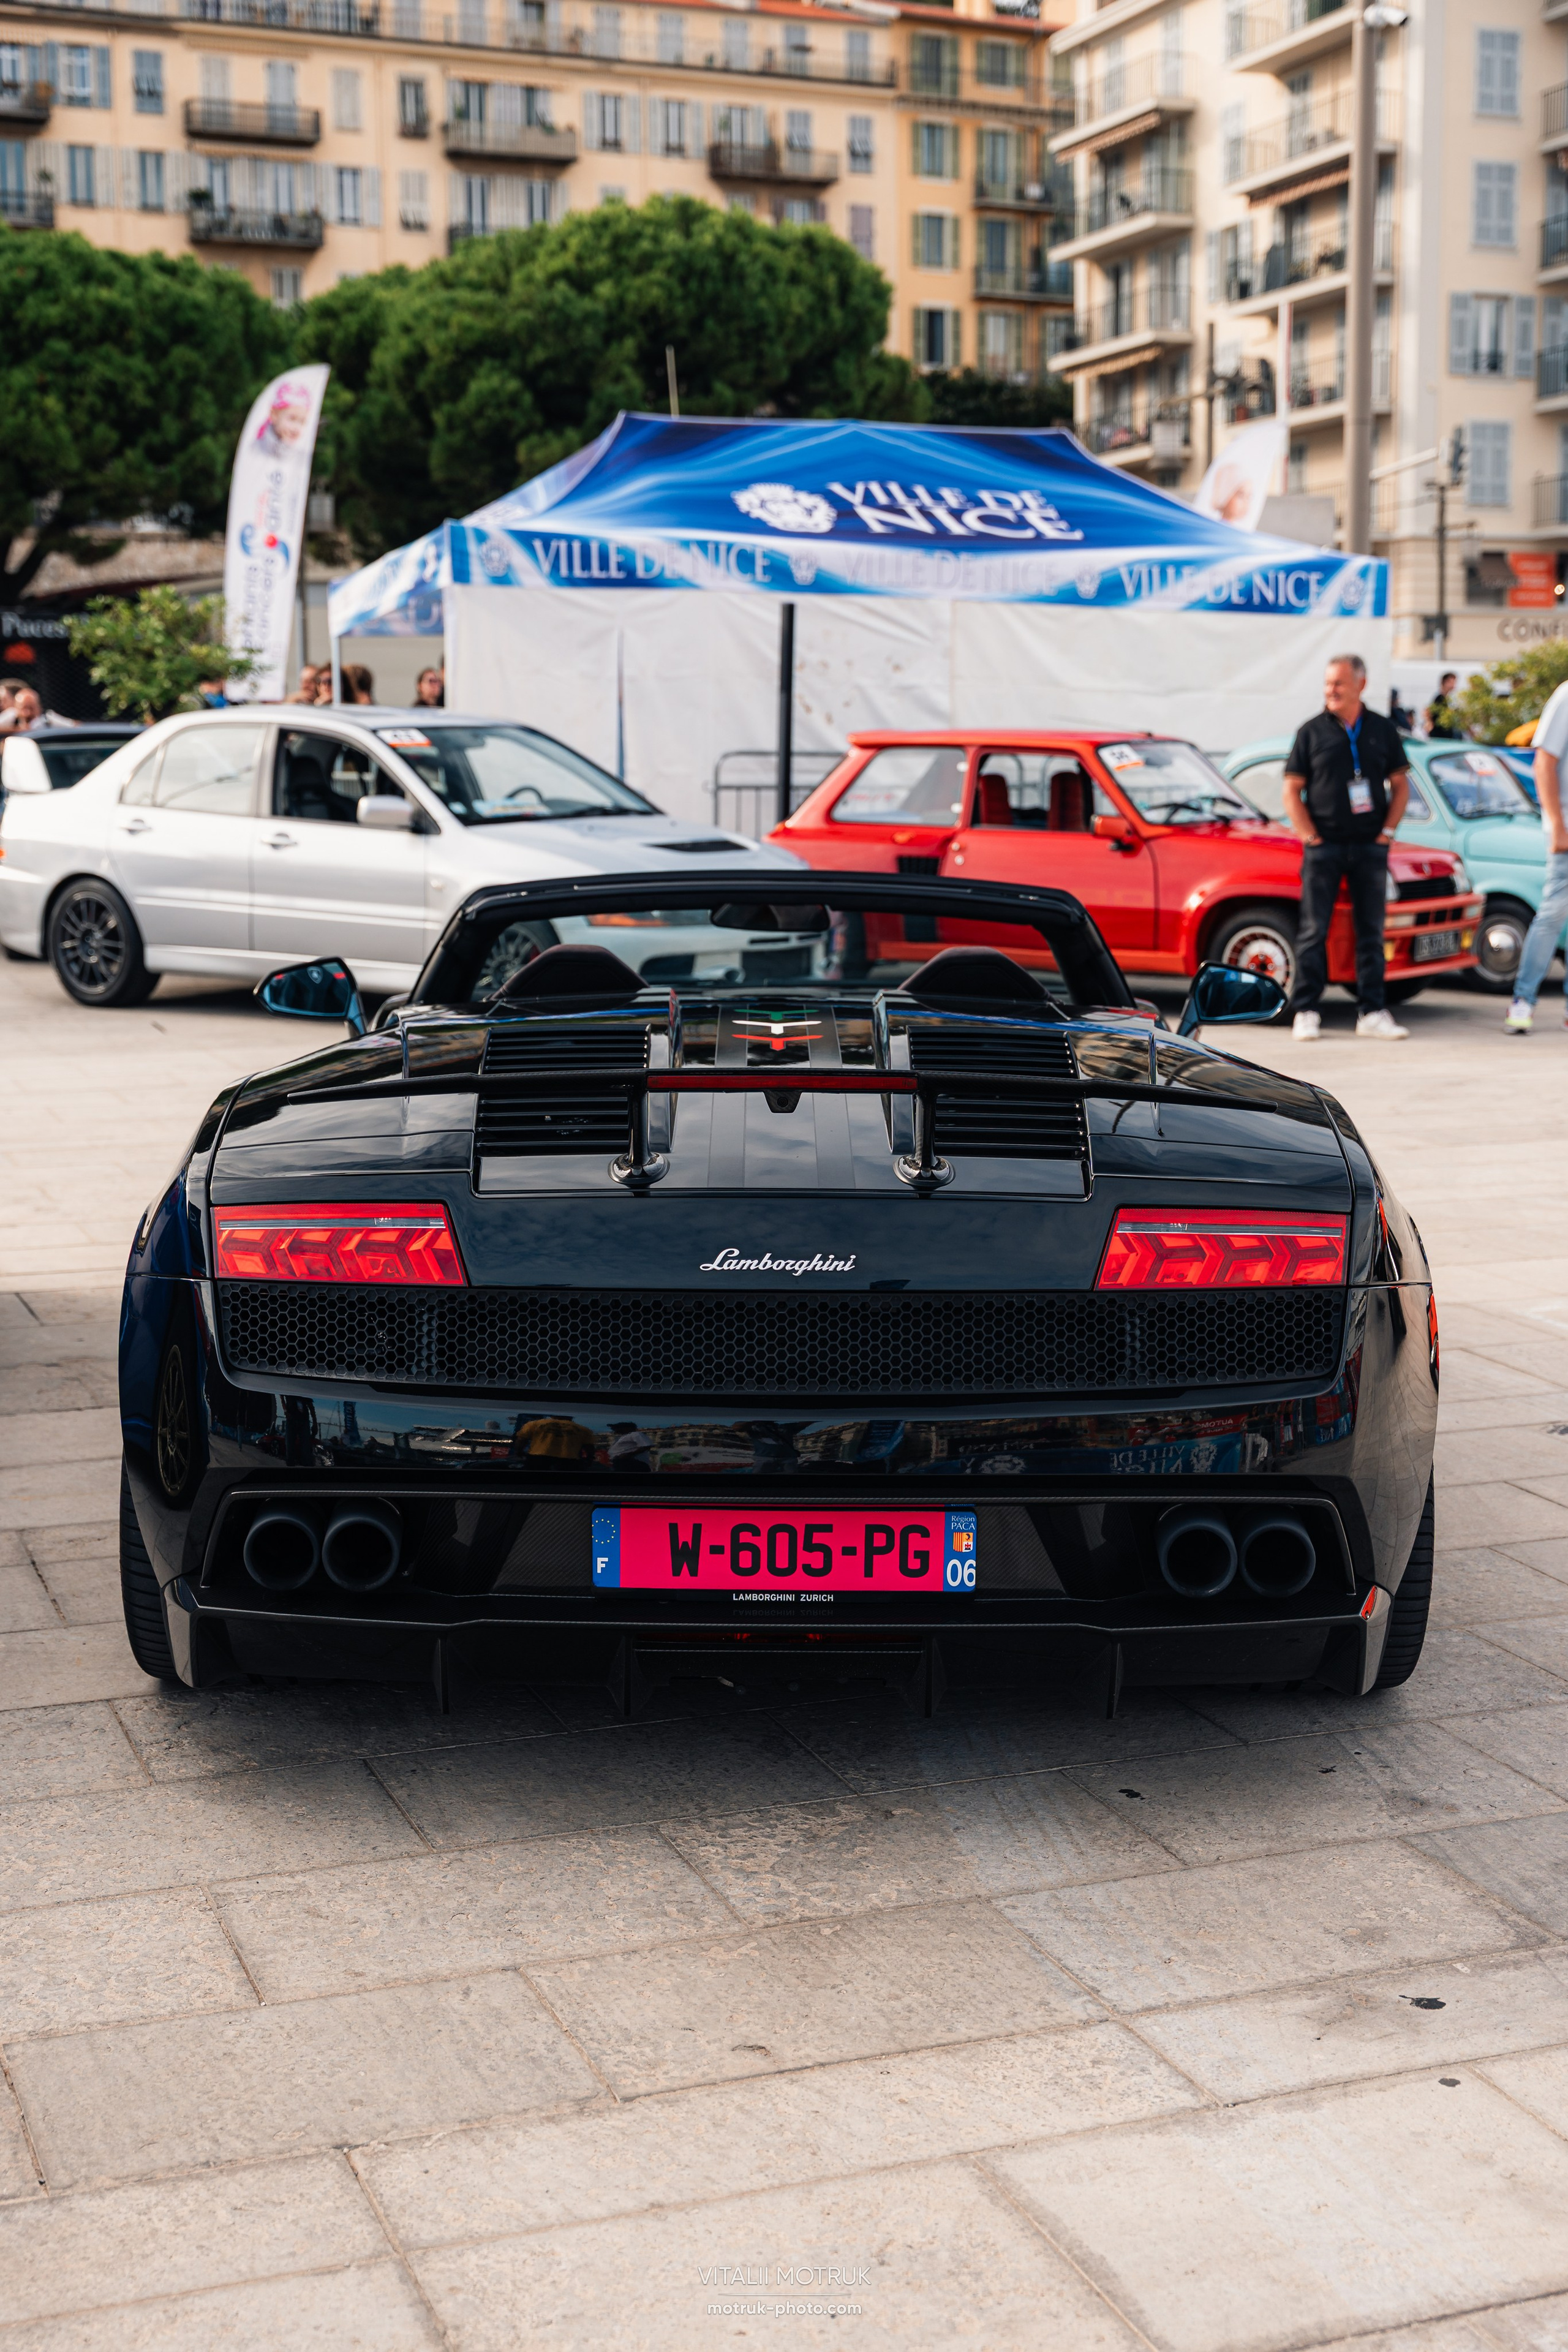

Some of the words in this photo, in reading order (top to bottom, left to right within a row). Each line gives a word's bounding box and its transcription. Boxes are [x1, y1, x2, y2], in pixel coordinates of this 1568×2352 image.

[826, 481, 974, 510] VILLE
[977, 489, 1061, 520] DE
[853, 505, 1084, 541] NICE
[533, 539, 627, 579] VILLE
[635, 540, 682, 580] DE
[687, 540, 772, 583] NICE
[843, 550, 926, 589] VILLE
[935, 551, 977, 592] DE
[984, 559, 1060, 597] NICE
[1119, 565, 1202, 603] VILLE
[1205, 568, 1247, 605] DE
[1251, 570, 1325, 608] NICE
[699, 1248, 856, 1276] Lamborghini
[597, 1558, 609, 1574] F
[669, 1523, 931, 1578] W-605-PG
[946, 1559, 976, 1588] 06
[733, 1593, 795, 1602] LAMBORGHINI
[800, 1593, 834, 1602] ZURICH
